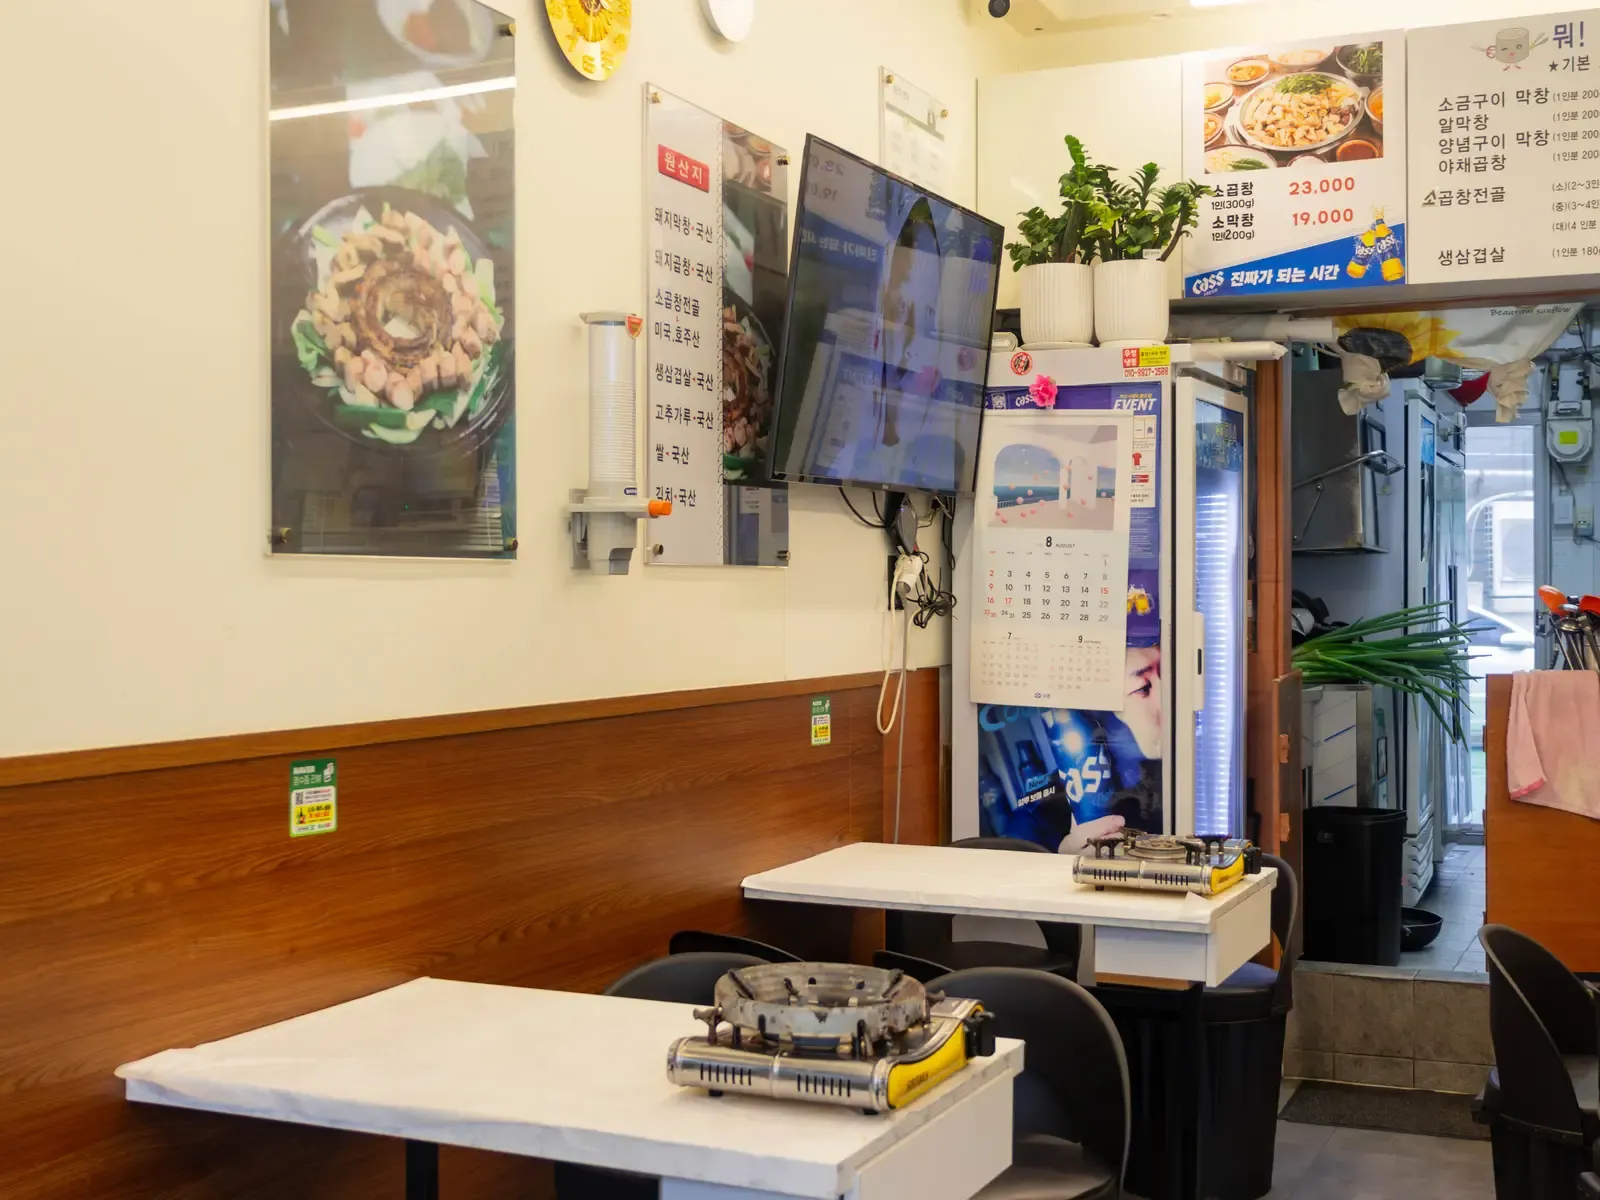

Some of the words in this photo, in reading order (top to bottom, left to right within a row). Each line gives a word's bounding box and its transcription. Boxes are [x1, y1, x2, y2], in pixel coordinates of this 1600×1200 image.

[1552, 20, 1585, 49] 뭐!
[1562, 54, 1591, 72] 기본
[1438, 91, 1505, 113] 소금구이
[1516, 87, 1550, 105] 막창
[1552, 91, 1579, 103] (1인분
[1581, 89, 1600, 100] 200
[1438, 114, 1489, 134] 알막창
[1552, 111, 1579, 123] (1인분
[1581, 109, 1600, 120] 200
[1438, 133, 1505, 155] 양념구이
[1516, 129, 1550, 147] 막창
[1552, 131, 1579, 143] (1인분
[1581, 129, 1600, 140] 200
[663, 151, 703, 185] 원산지
[1438, 154, 1507, 175] 야채곱창
[1552, 151, 1579, 163] (1인분
[1581, 149, 1600, 160] 200
[1212, 182, 1254, 198] 소곱창
[1289, 177, 1355, 196] 23,000
[1421, 186, 1506, 208] 소곱창전골
[1551, 178, 1600, 192] (소)(2~3인
[1211, 199, 1255, 211] 1인(300g)
[1551, 199, 1600, 213] (중)(3~4인
[1212, 213, 1254, 230] 소막창
[1292, 208, 1354, 226] 19,000
[1580, 219, 1597, 231] 인분
[1211, 229, 1255, 242] 1인(200g)
[1438, 246, 1505, 267] 생삼겹살
[1551, 247, 1578, 259] (1인분
[1581, 246, 1600, 256] 180
[1230, 268, 1273, 288] 진짜가
[1276, 267, 1306, 284] 되는
[1309, 264, 1341, 281] 시간
[655, 288, 700, 318] 소곱창전골
[1113, 398, 1157, 411] EVENT
[1045, 536, 1053, 548] 8
[1004, 597, 1012, 605] 17
[1060, 613, 1069, 621] 27
[1007, 632, 1012, 640] 7
[1078, 635, 1083, 643] 9
